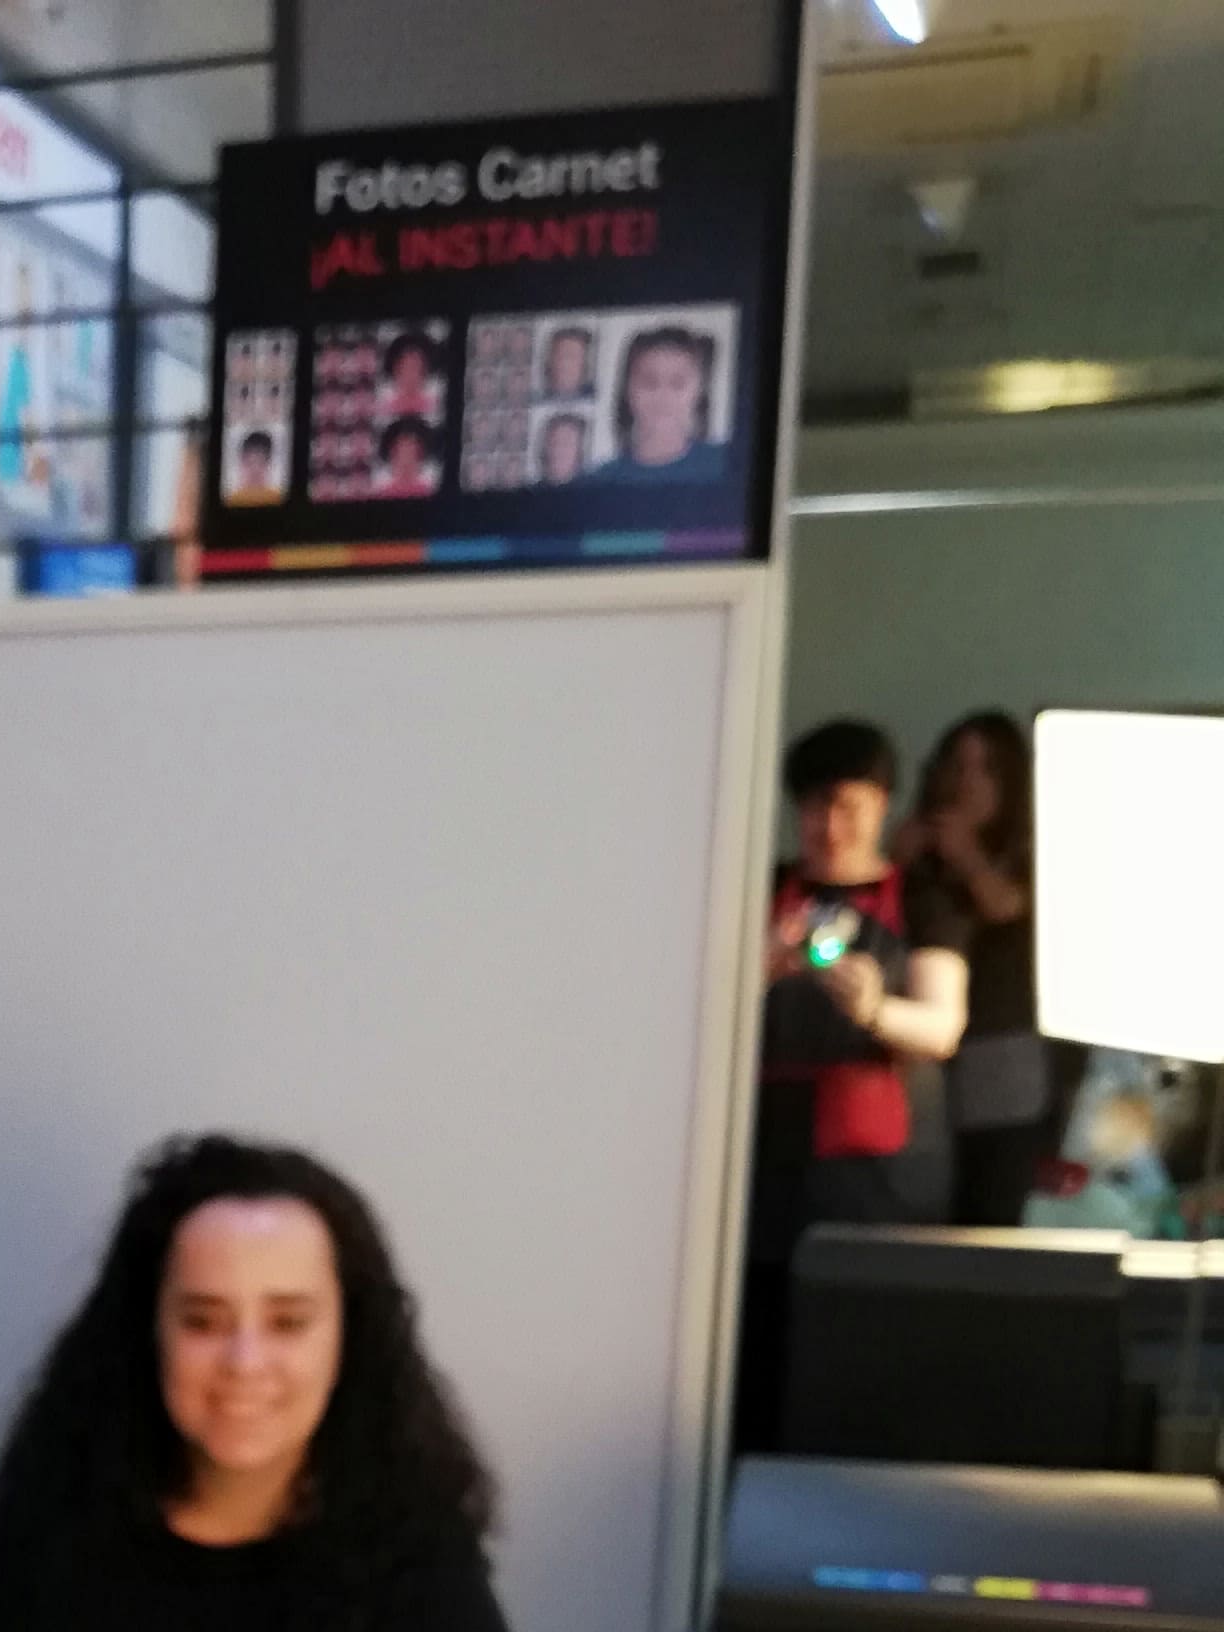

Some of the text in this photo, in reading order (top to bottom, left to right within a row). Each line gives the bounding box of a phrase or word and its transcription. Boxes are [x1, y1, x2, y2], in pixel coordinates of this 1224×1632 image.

[315, 141, 660, 215] Fotos Carnet
[398, 208, 657, 271] INSTANTE!
